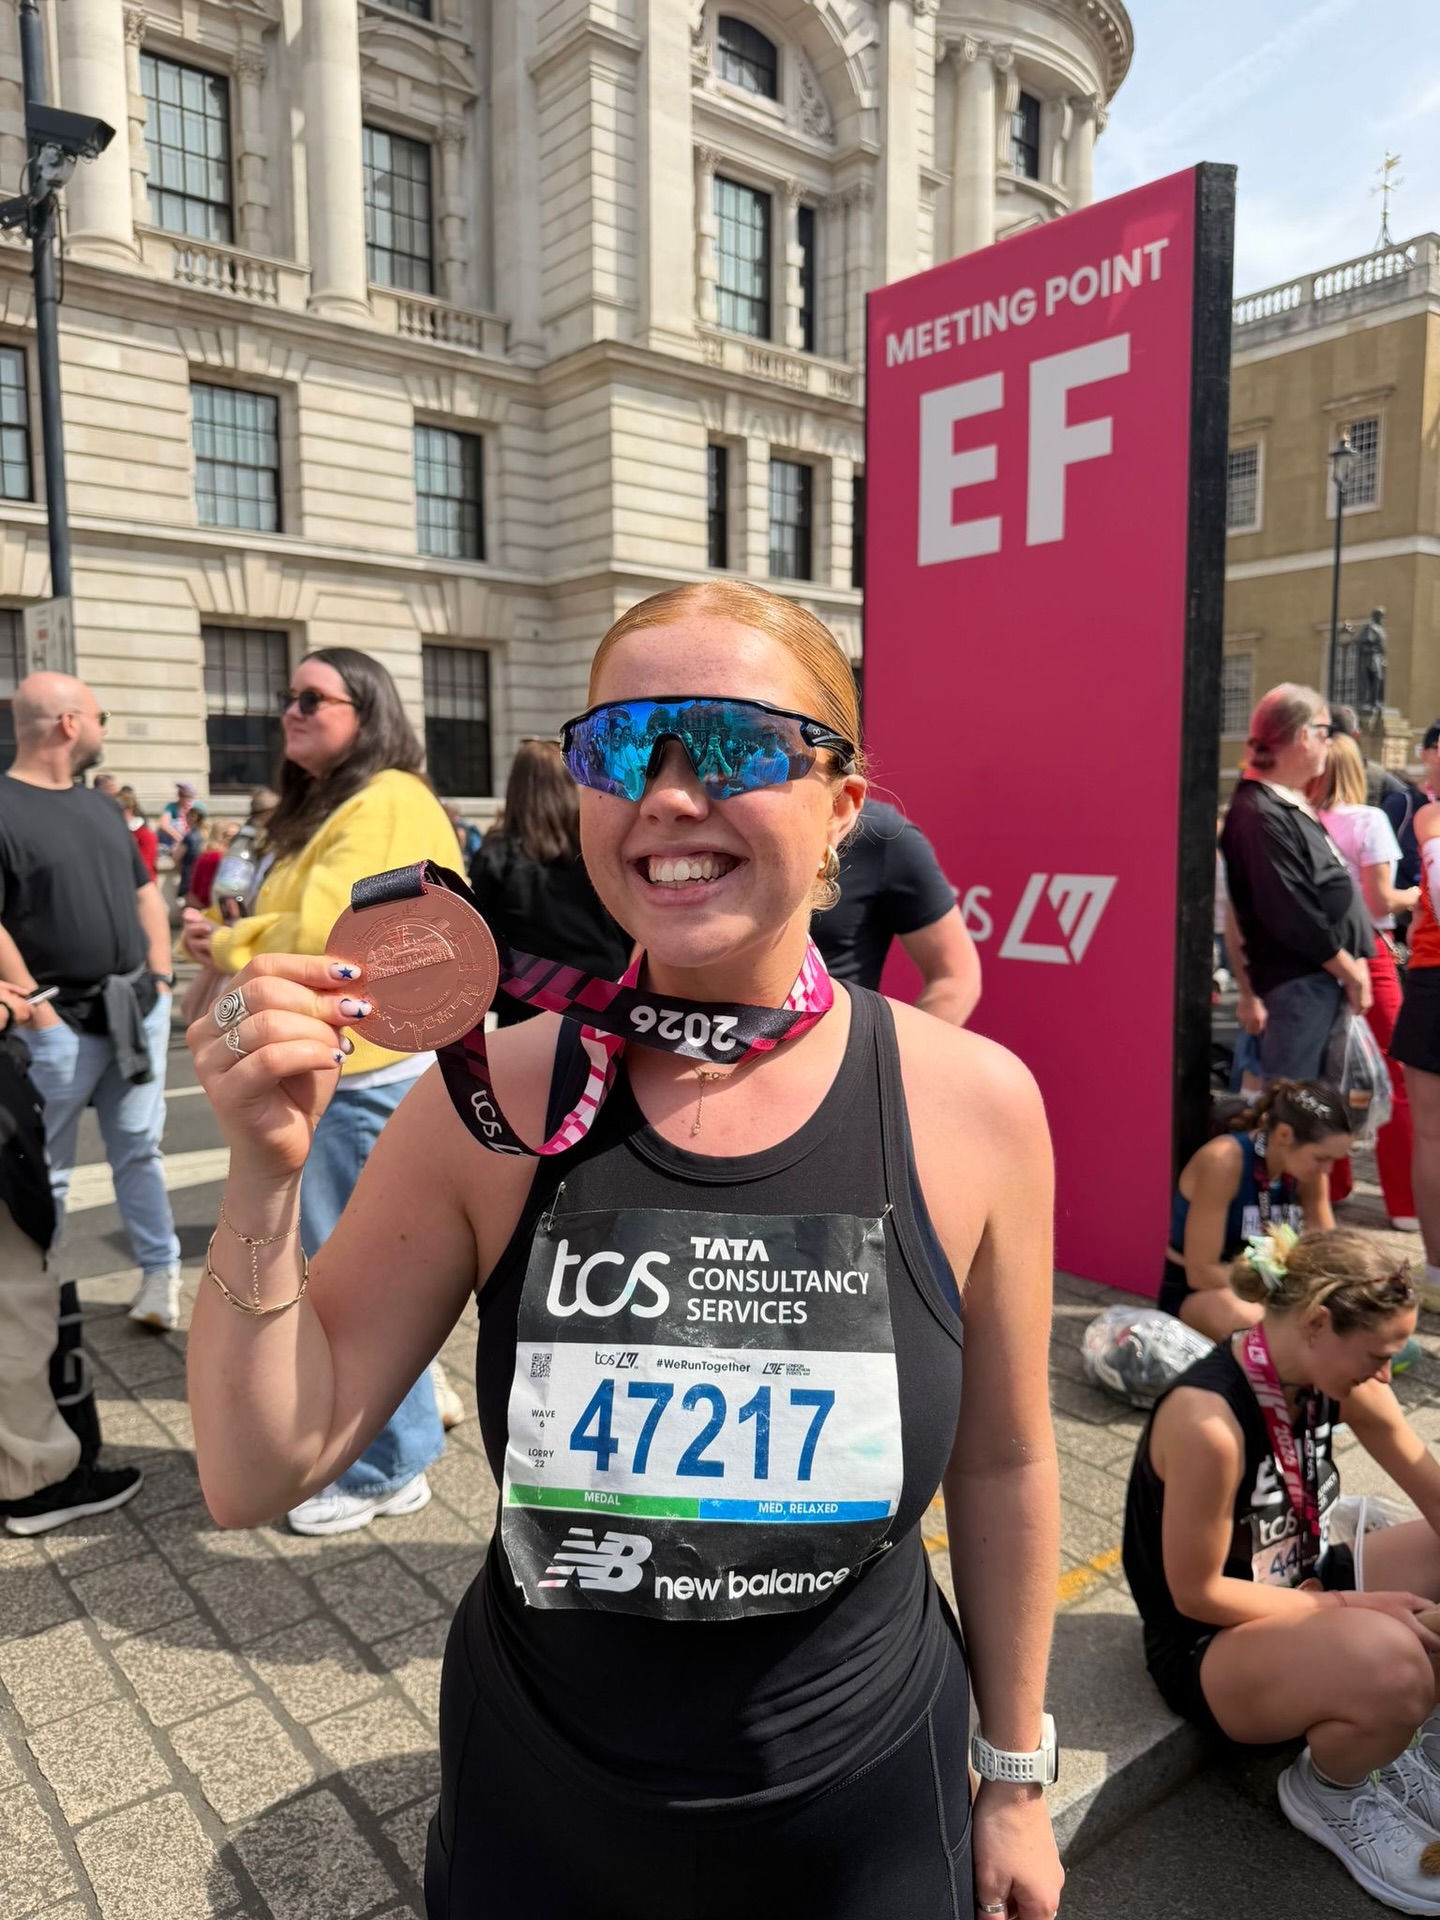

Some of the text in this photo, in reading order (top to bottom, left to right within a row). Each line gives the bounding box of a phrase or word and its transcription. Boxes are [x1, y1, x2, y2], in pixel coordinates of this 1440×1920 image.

[886, 237, 1169, 368] MEETING POINT
[917, 332, 1131, 567] EF
[629, 1005, 739, 1052] 2026
[690, 1236, 770, 1262] TATA
[687, 1268, 870, 1296] CONSULTANCY
[686, 1298, 808, 1324] SERVICES
[656, 1358, 751, 1374] #WeRunTogether
[531, 1409, 556, 1419] WAVE
[539, 1420, 545, 1428] 6
[569, 1378, 836, 1481] 47217
[528, 1448, 555, 1459] LORRY
[534, 1459, 545, 1468] 22
[584, 1491, 621, 1506] MEDAL
[758, 1502, 839, 1517] MED, RELAXED
[654, 1566, 850, 1600] new balance
